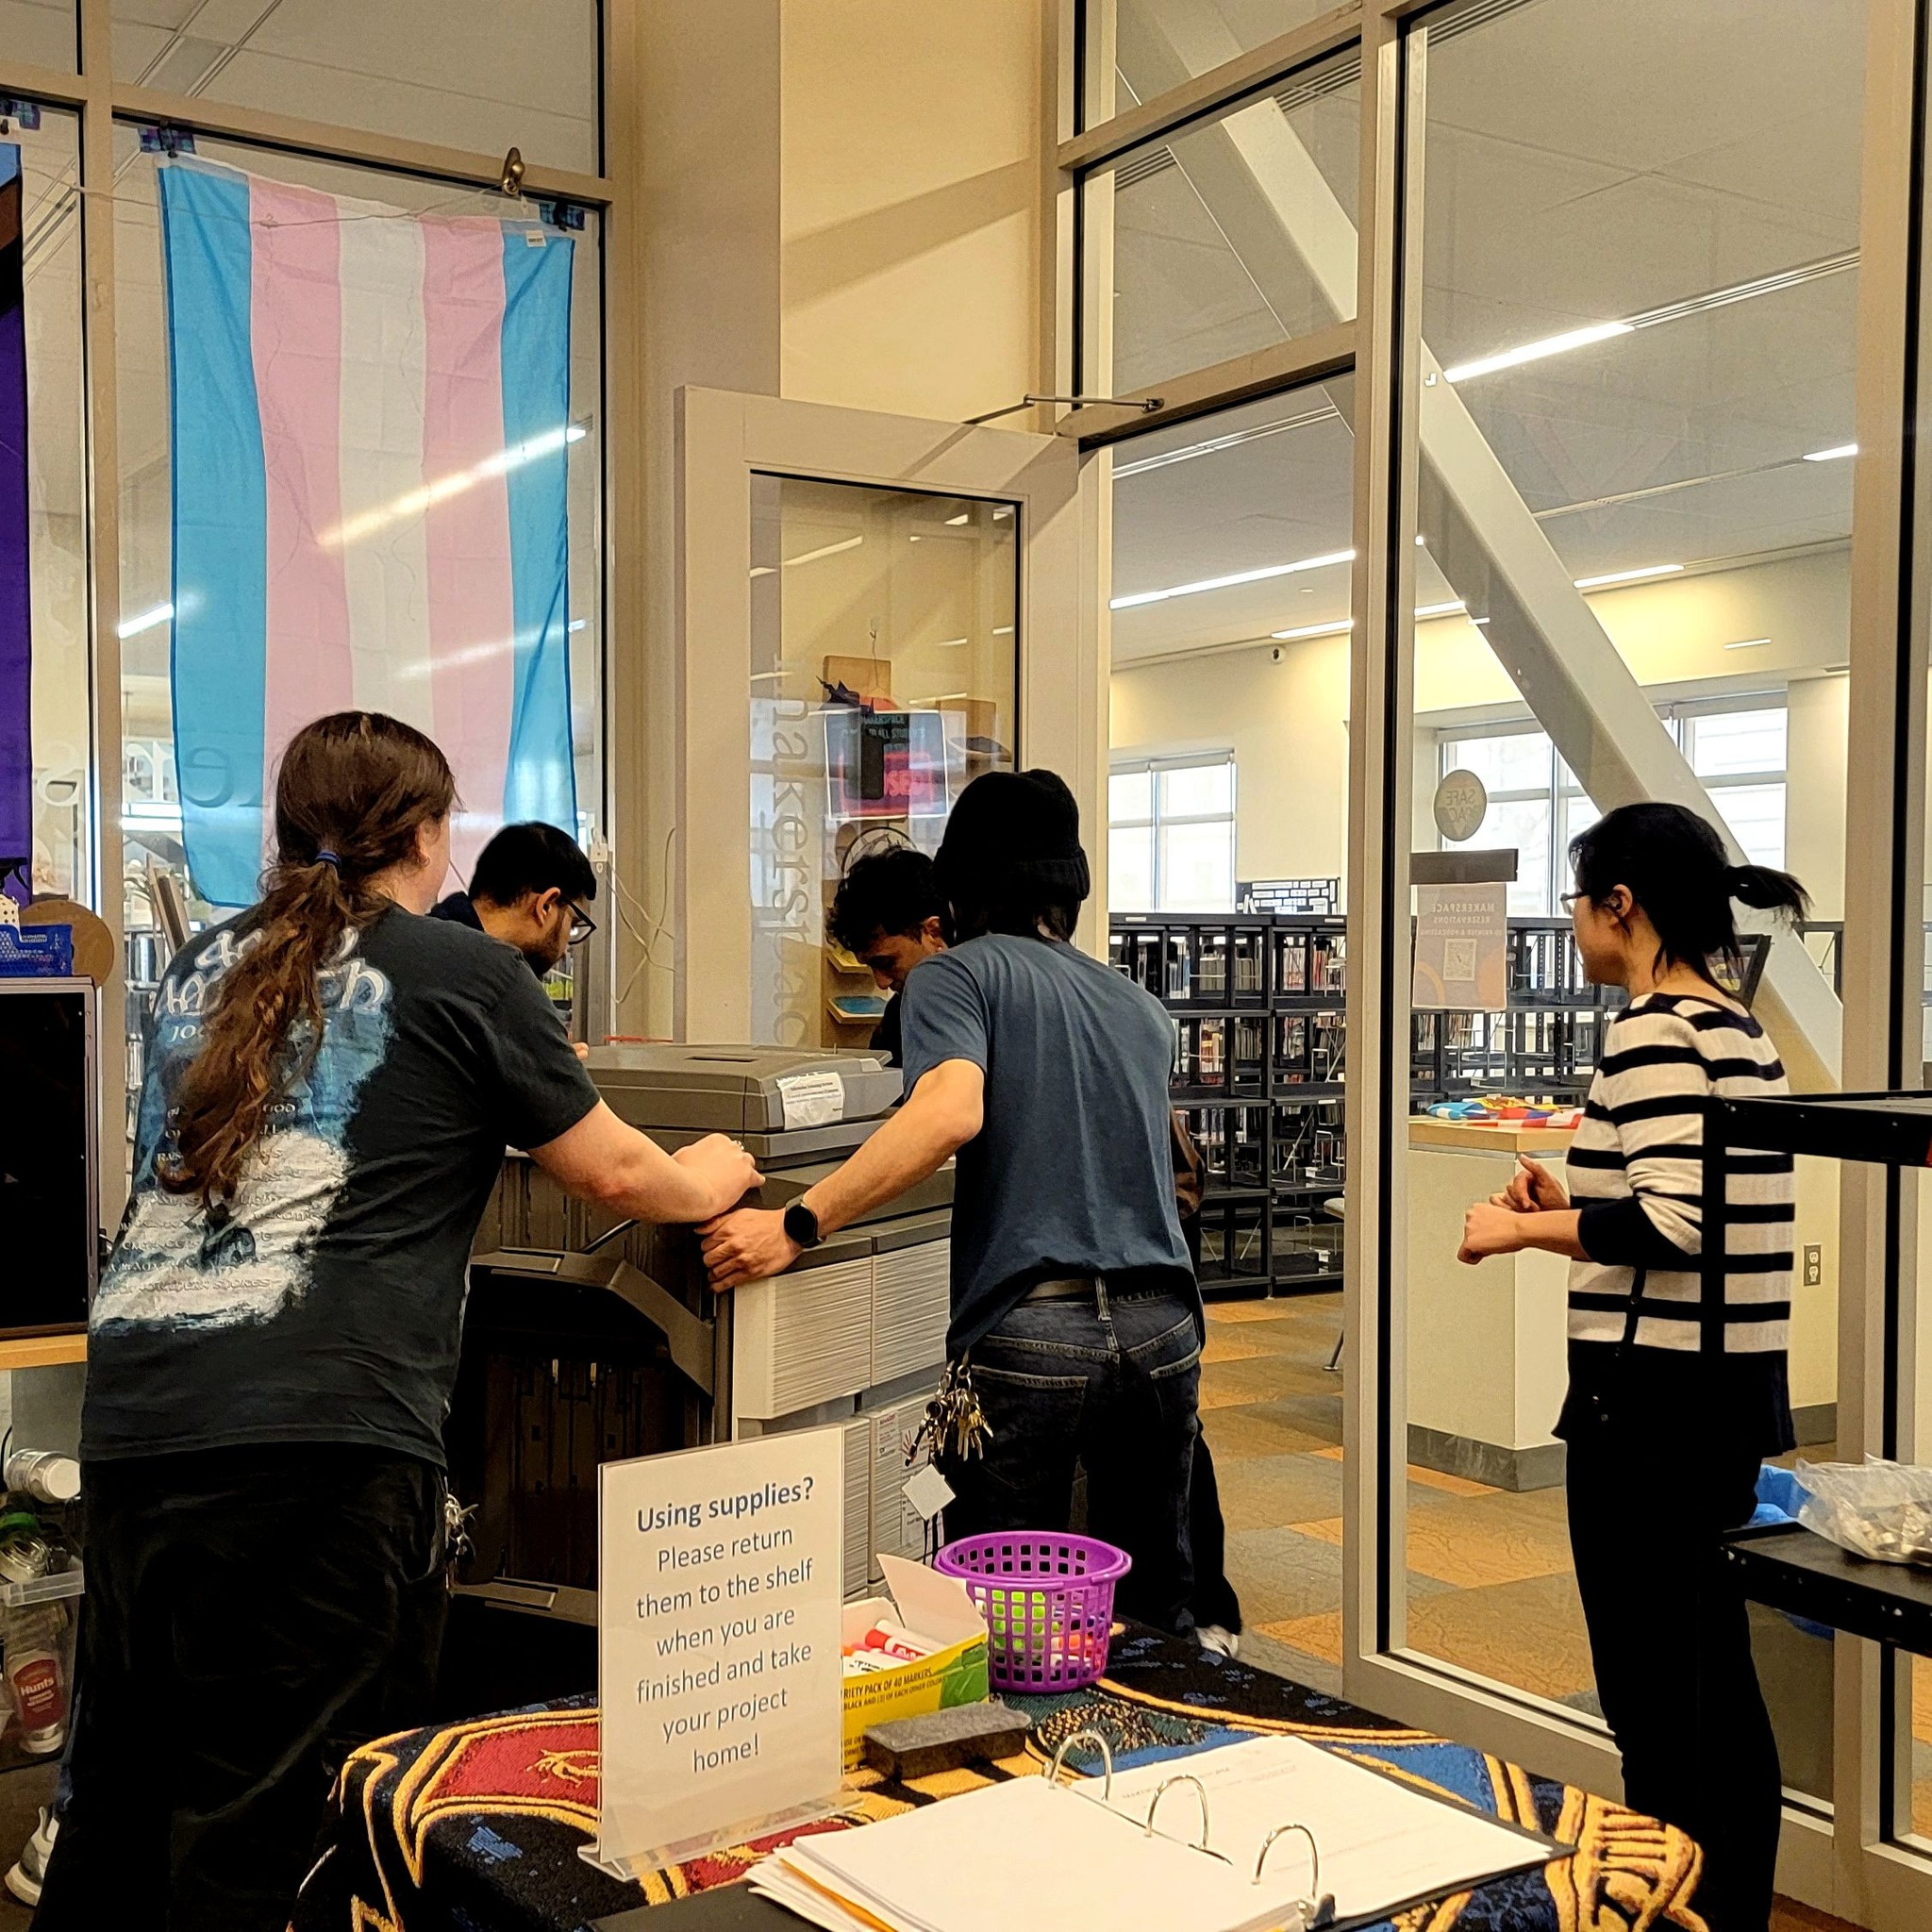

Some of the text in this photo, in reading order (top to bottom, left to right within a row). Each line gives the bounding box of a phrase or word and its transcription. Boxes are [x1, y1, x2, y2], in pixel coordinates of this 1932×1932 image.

[754, 651, 815, 1046] makerspac
[638, 1475, 814, 1533] Using supplies?
[658, 1528, 792, 1573] Please return
[636, 1557, 813, 1619] them to the shelf
[657, 1608, 795, 1657] when you are
[636, 1642, 812, 1704] finished and take
[843, 1685, 864, 1700] RIETY
[864, 1682, 882, 1695] PACK
[884, 1679, 892, 1690] OF
[904, 1666, 933, 1685] MARKERS
[662, 1688, 788, 1744] your project
[864, 1696, 876, 1707] AND
[693, 1732, 759, 1774] home!
